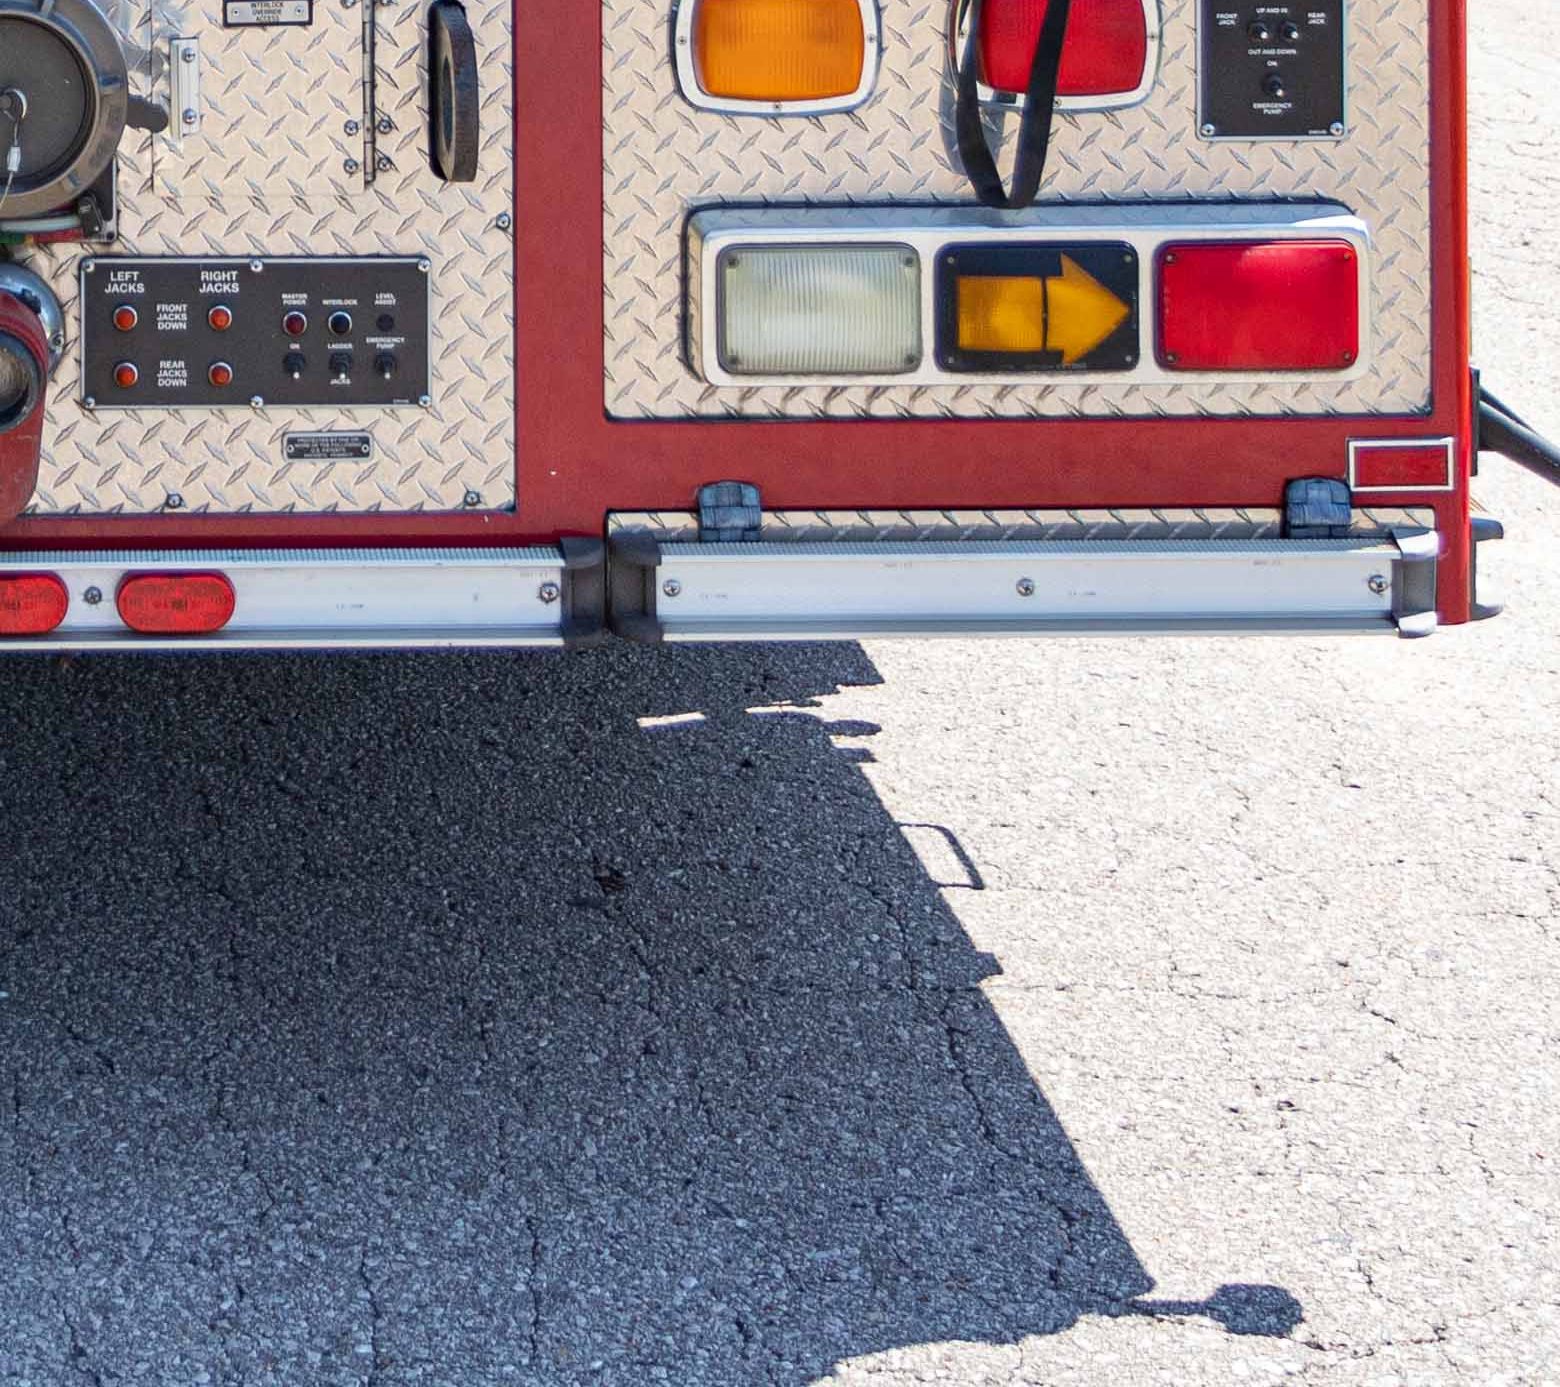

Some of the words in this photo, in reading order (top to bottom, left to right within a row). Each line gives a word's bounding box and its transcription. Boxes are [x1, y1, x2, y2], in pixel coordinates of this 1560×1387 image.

[110, 271, 139, 282] LEFT
[201, 271, 238, 282] RIGHT
[105, 283, 145, 293] JACKS
[199, 283, 239, 293] JACKS
[156, 304, 188, 312] FRONT
[156, 313, 188, 321] JACKS
[157, 322, 187, 330] DOWN
[159, 361, 185, 369] REAR
[156, 369, 188, 378] JACKS
[157, 379, 187, 387] DOWN
